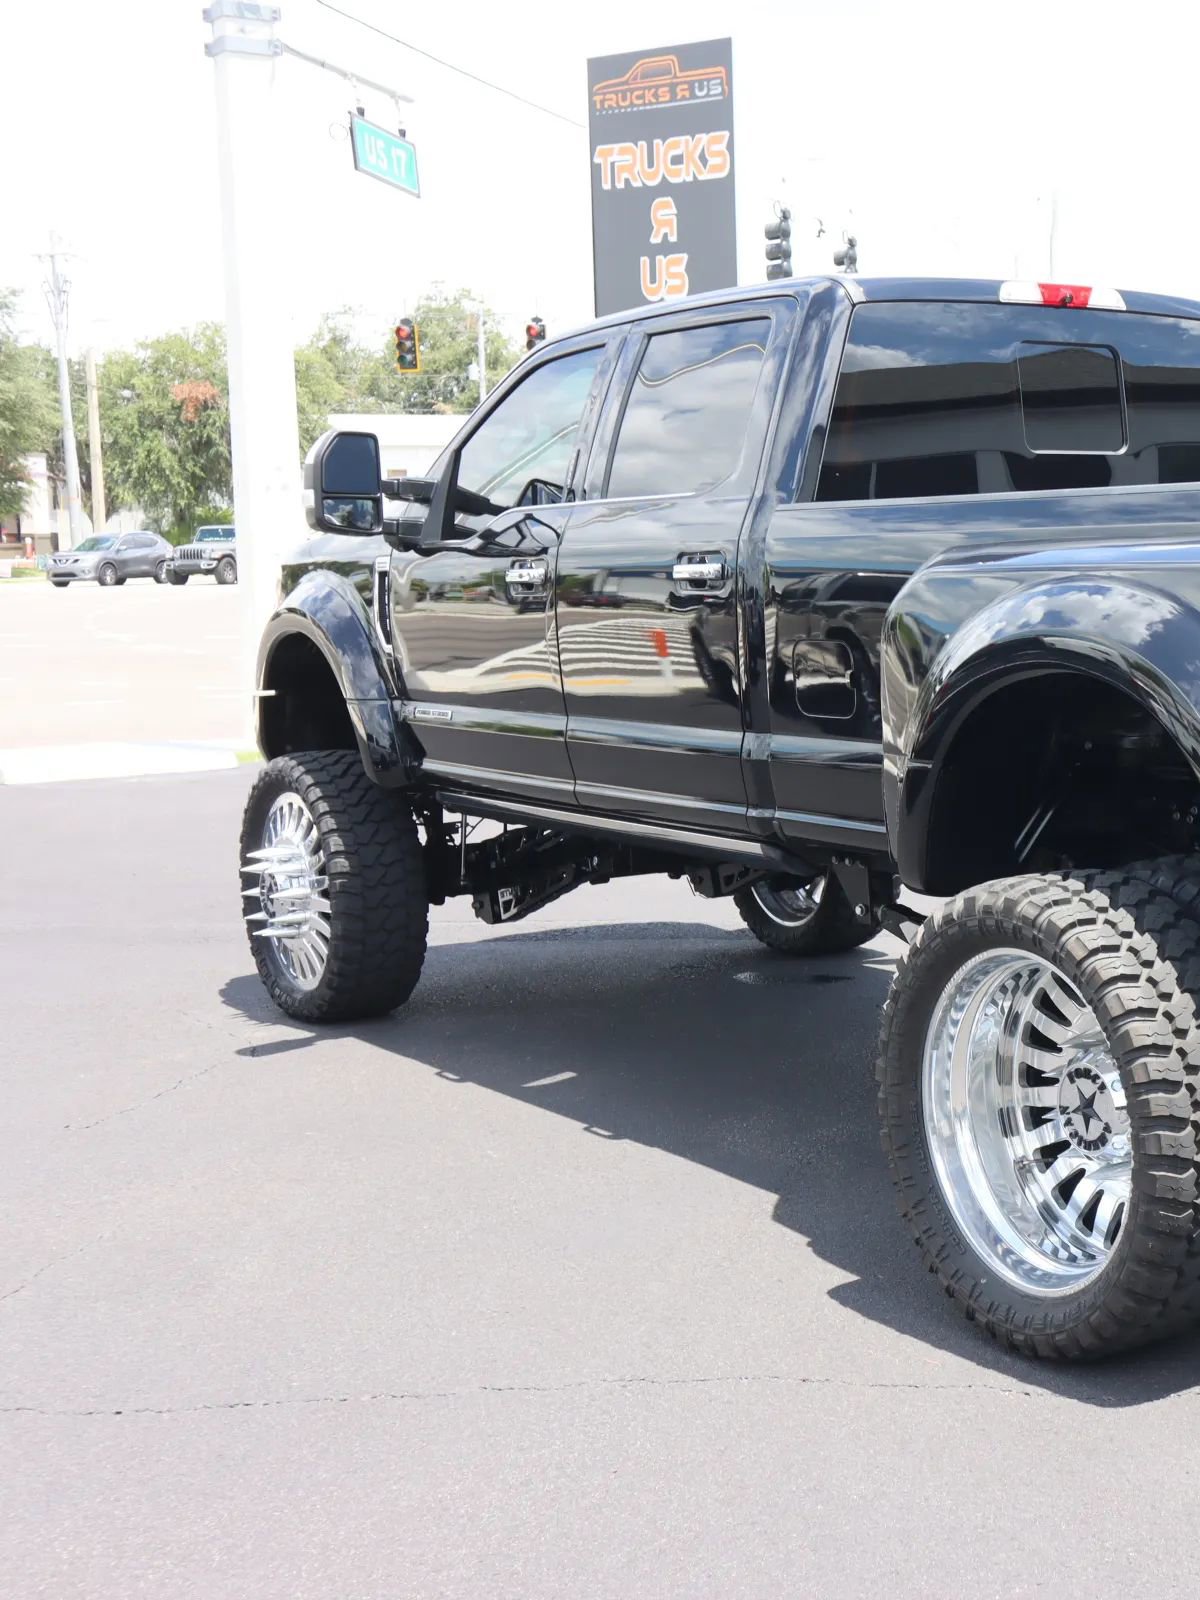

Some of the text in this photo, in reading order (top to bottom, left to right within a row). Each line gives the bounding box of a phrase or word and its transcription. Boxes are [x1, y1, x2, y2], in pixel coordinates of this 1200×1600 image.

[593, 87, 671, 109] TRUCKS
[694, 79, 722, 97] US
[364, 132, 407, 178] US 17
[593, 130, 730, 190] TRUCKS
[640, 252, 689, 302] US
